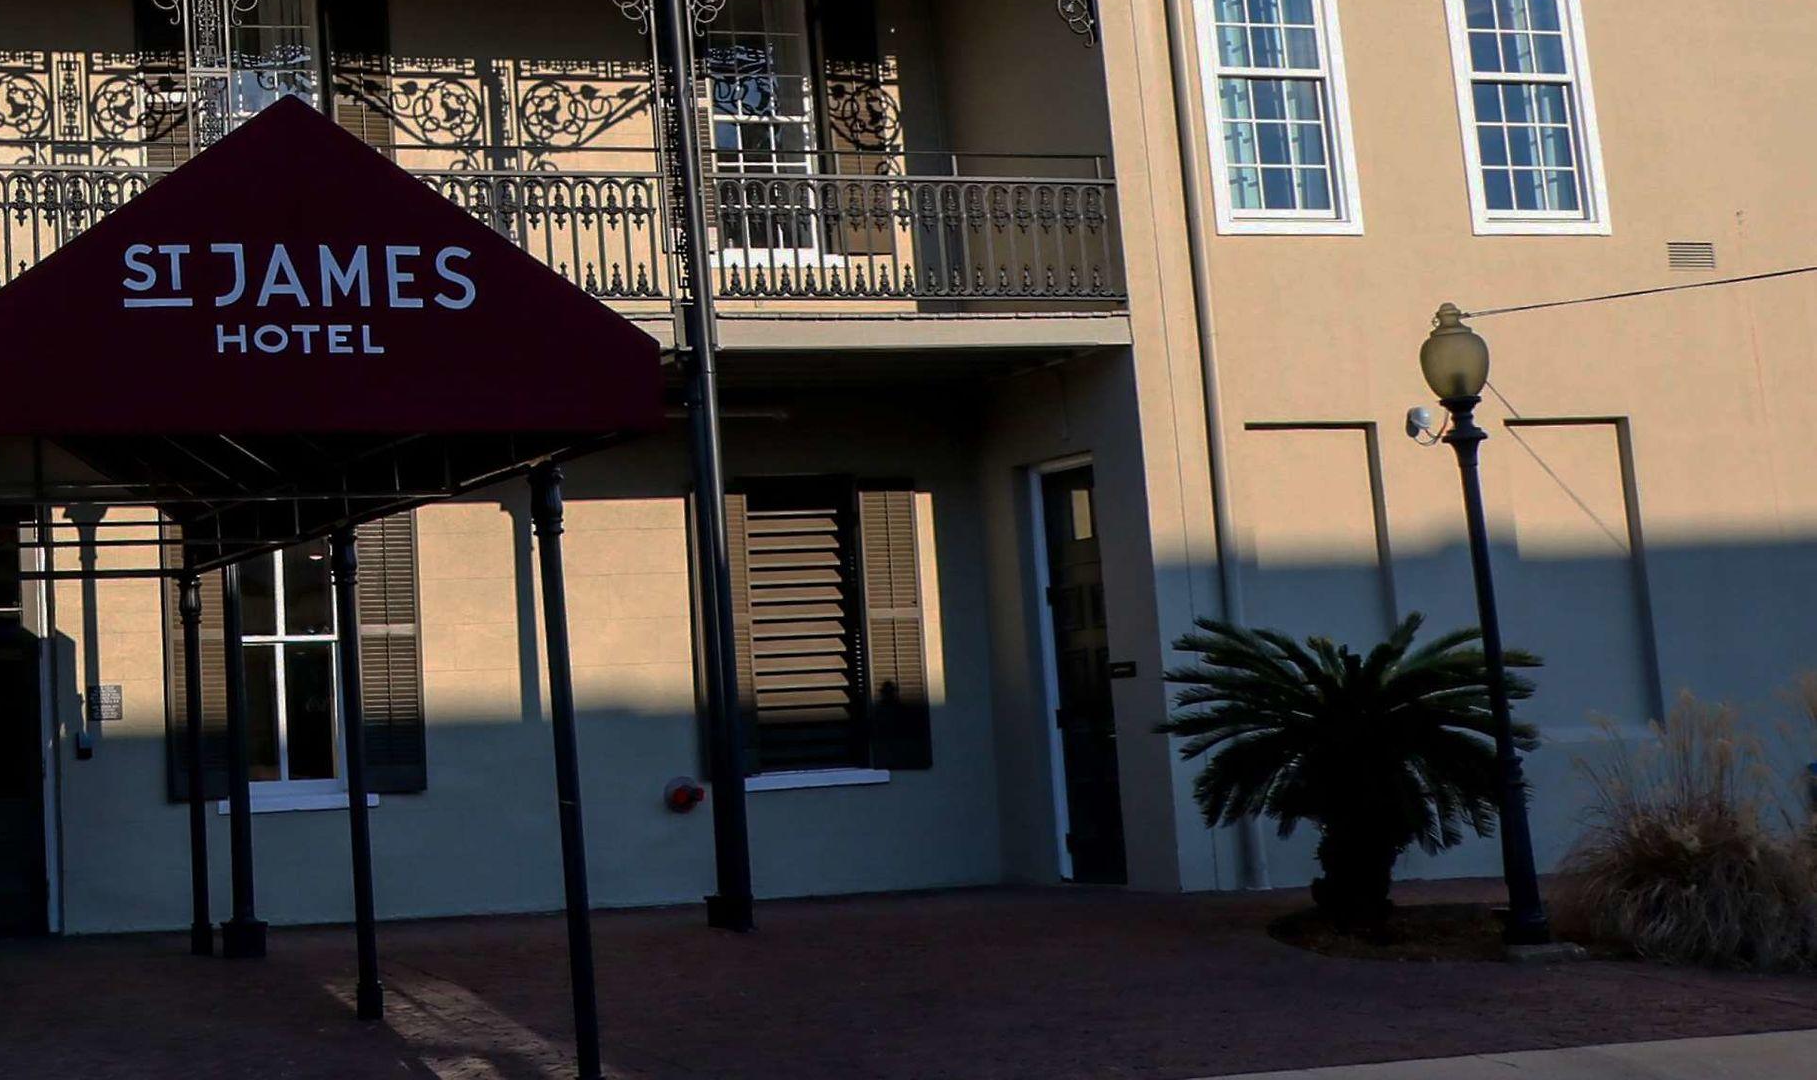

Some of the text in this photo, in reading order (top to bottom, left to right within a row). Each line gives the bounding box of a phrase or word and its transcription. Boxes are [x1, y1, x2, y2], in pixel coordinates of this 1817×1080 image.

[122, 243, 476, 310] ST JAMES
[216, 324, 385, 354] HOTEL
